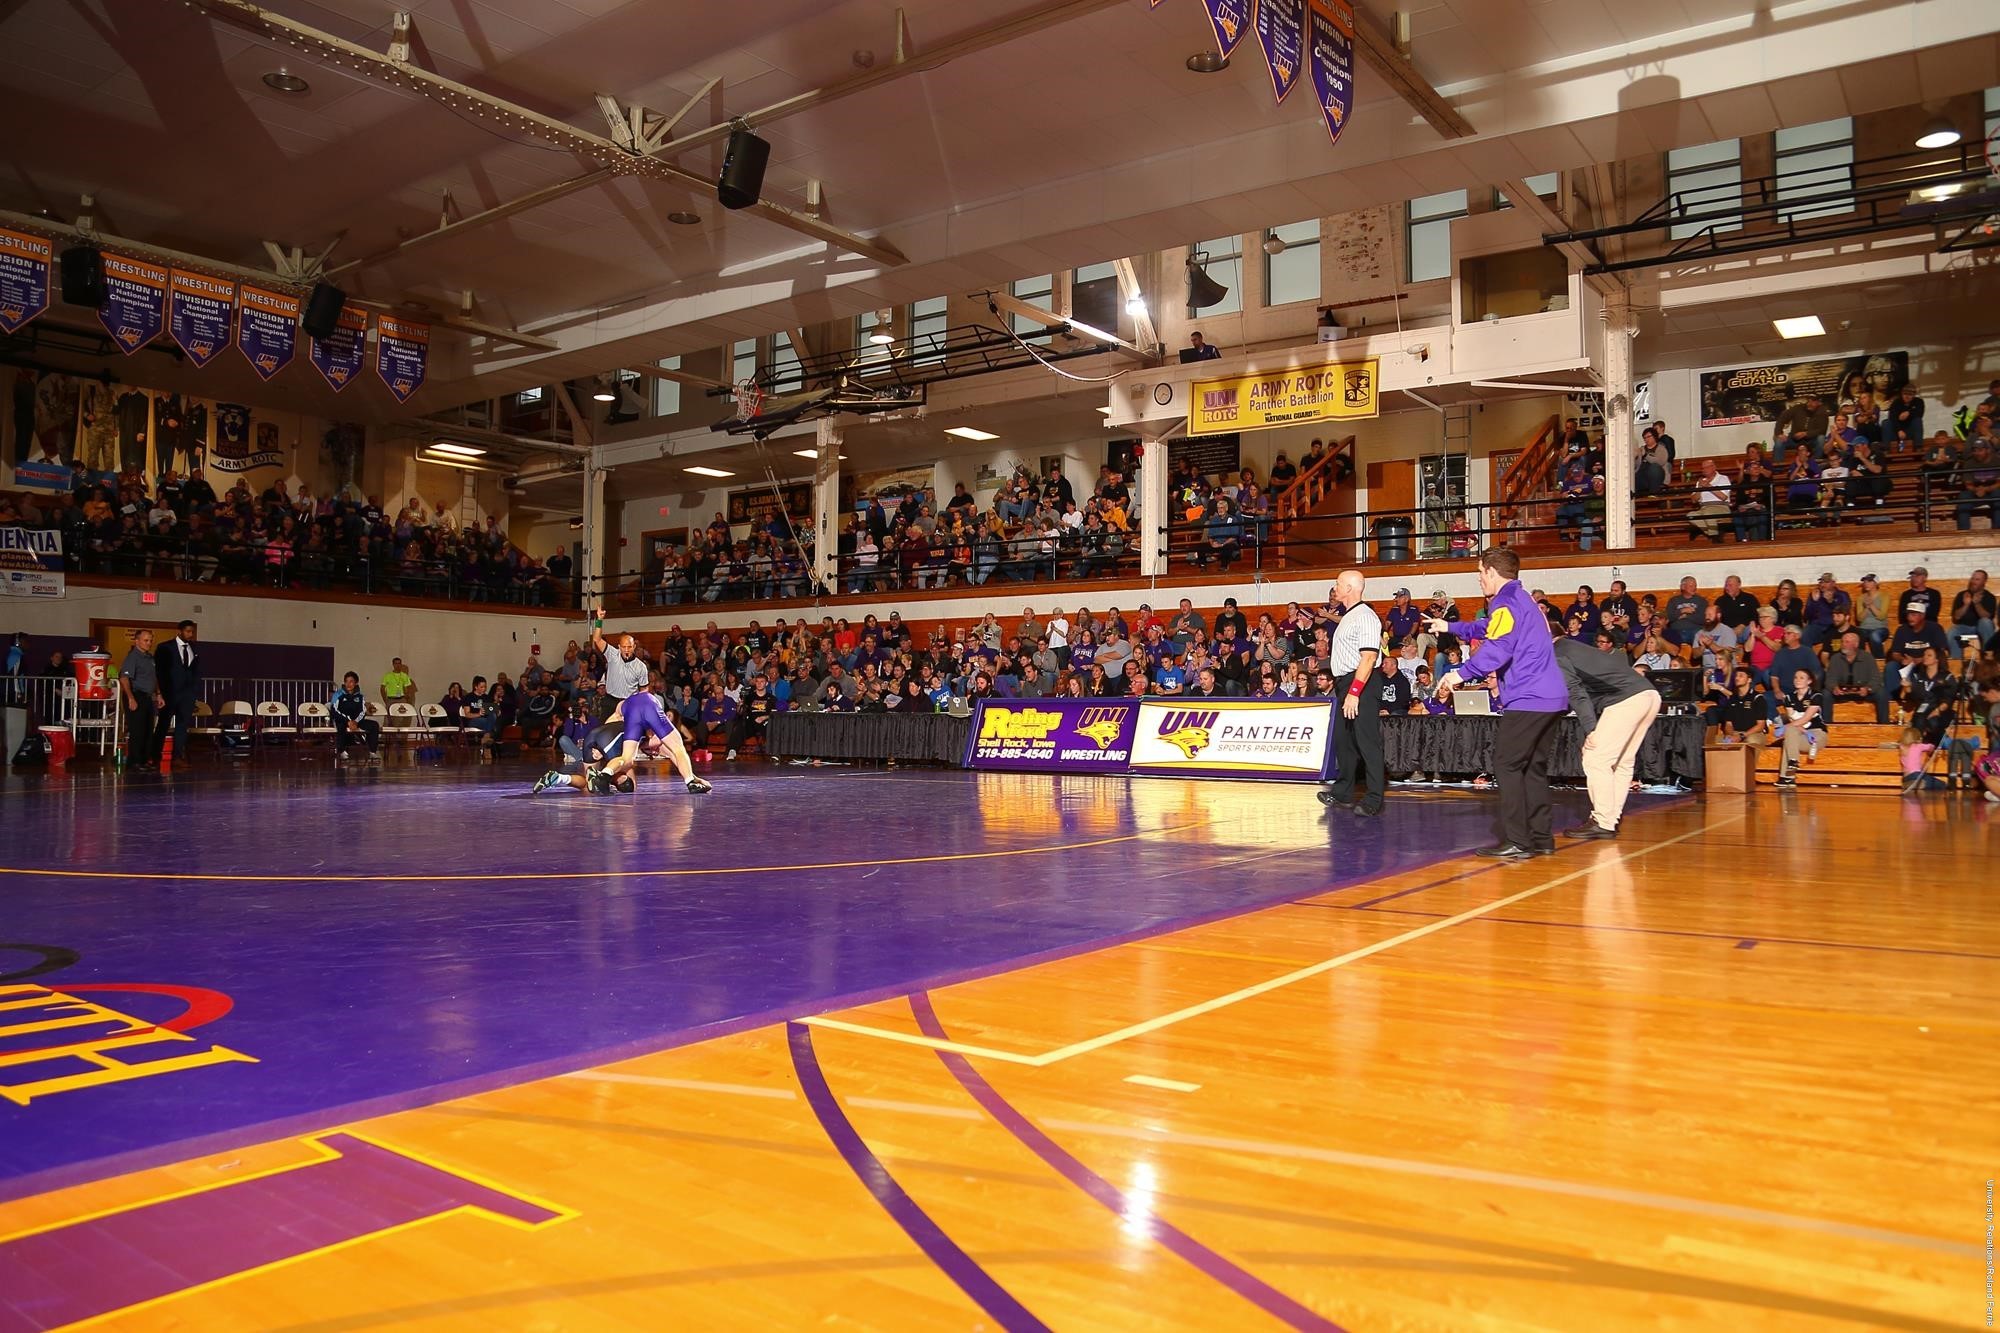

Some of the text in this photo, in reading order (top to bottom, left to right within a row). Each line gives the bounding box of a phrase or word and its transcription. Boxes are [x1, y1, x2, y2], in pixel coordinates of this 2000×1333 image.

[1325, 72, 1343, 92] 1950
[0, 264, 31, 276] ational
[174, 274, 233, 296] WRESTLING
[109, 293, 155, 310] Champions
[116, 288, 150, 302] National
[174, 292, 219, 309] DIVISION
[243, 290, 298, 312] WRESTLING
[182, 308, 225, 323] Champions
[186, 302, 219, 315] National
[243, 307, 286, 324] DIVISION
[250, 323, 289, 338] Champions
[254, 318, 285, 330] National
[381, 320, 429, 338] WRESTLING
[1728, 373, 1787, 388] GUARD
[1737, 367, 1778, 380] STAY
[1250, 379, 1291, 398] ARMY
[1295, 371, 1334, 392] ROTC
[1203, 388, 1238, 408] UNI
[1249, 395, 1287, 411] Panther
[1290, 390, 1334, 408] Battalion
[1203, 408, 1238, 423] ROTC
[1264, 413, 1292, 423] NATIONAL
[1293, 410, 1313, 419] GUARD
[218, 454, 276, 469] ARMY ROTC
[89, 665, 104, 681] G
[1078, 707, 1129, 730] UNI
[1158, 711, 1221, 736] UNI
[1221, 725, 1314, 740] PANTHER
[977, 739, 1056, 749] Shell Rock, Iowa
[1217, 744, 1312, 754] SPORTS PROPERTIES
[976, 748, 1054, 760] 319-885-4540
[1060, 749, 1128, 761] WRESTLING
